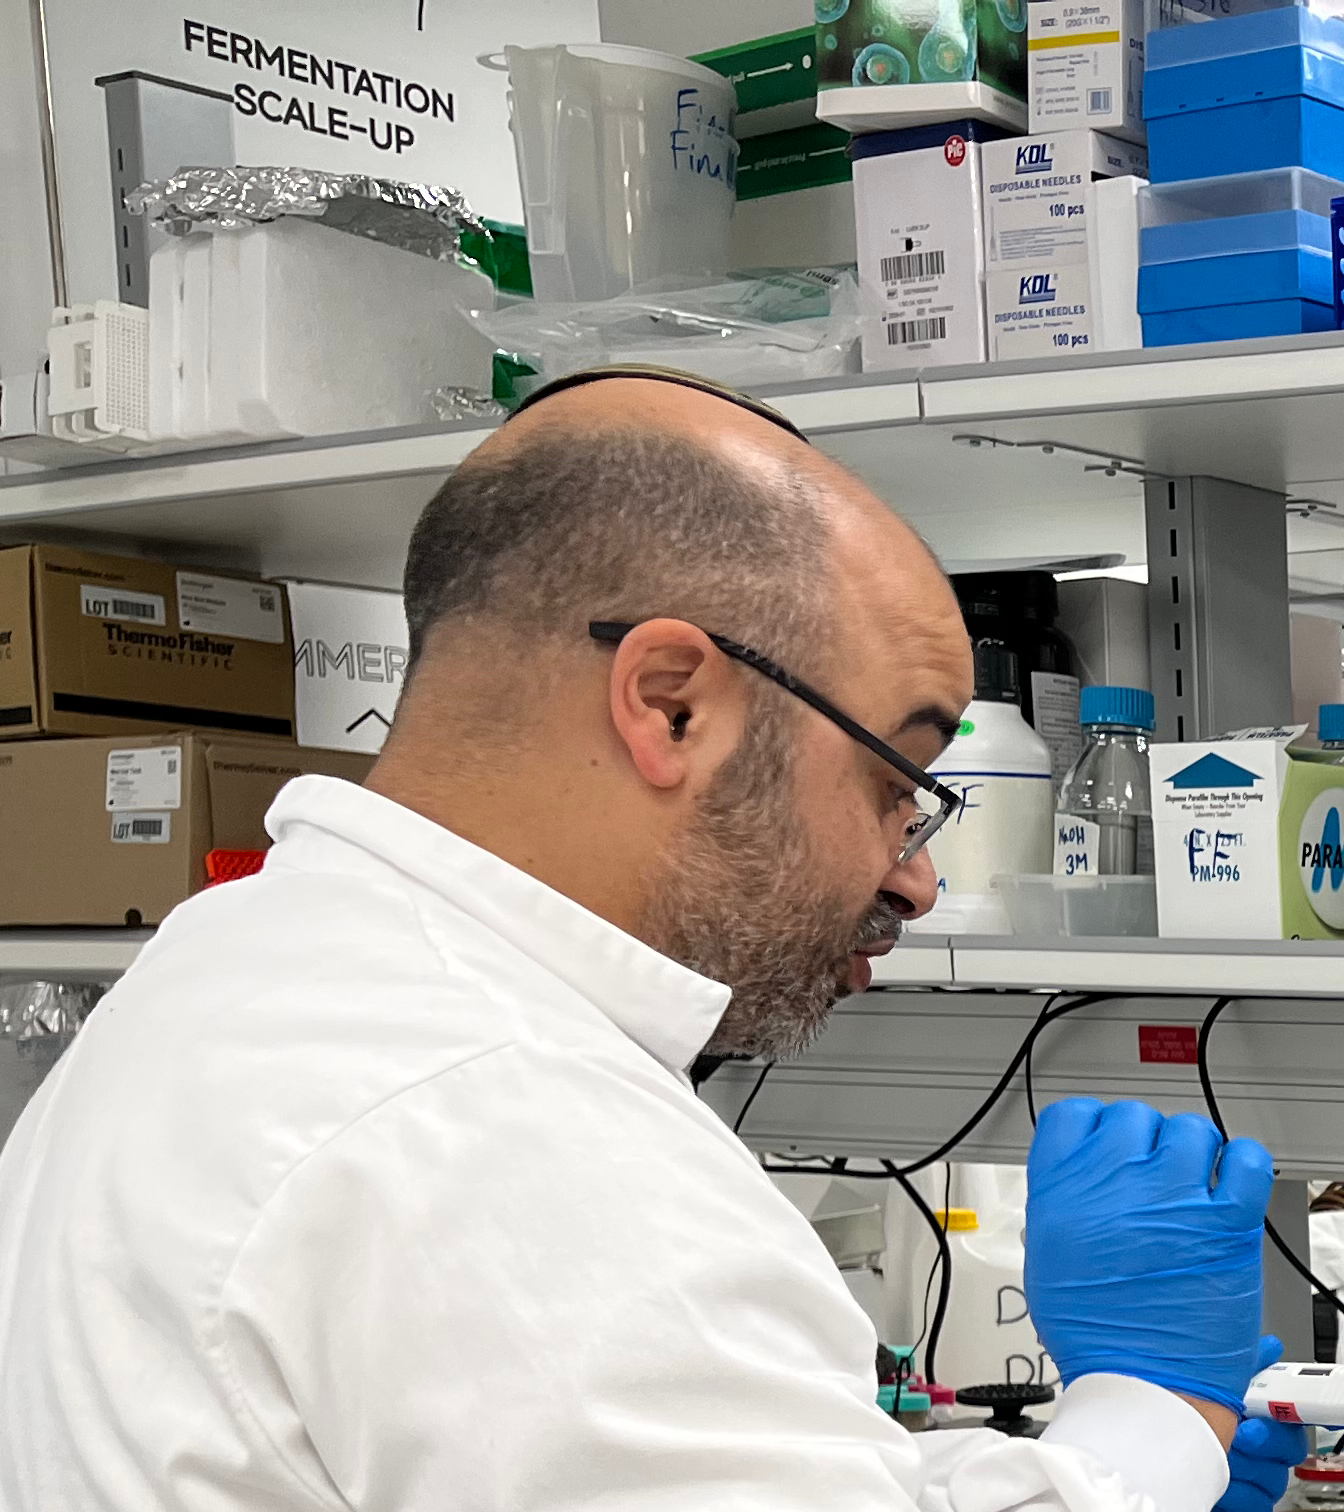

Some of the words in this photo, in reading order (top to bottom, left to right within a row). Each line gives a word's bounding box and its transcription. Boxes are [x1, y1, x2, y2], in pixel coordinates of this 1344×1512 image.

[182, 19, 456, 123] FERMENTATION
[232, 83, 416, 155] SCALE-UP
[989, 178, 1041, 194] DISPOSABLE
[1042, 174, 1082, 188] NEEDLES
[1049, 204, 1066, 217] 100
[1067, 204, 1084, 218] pcs
[995, 307, 1044, 324] DISPOSABLE
[1045, 304, 1086, 318] NEEDLES
[1052, 334, 1069, 347] 100
[1071, 334, 1089, 349] pcs
[86, 599, 110, 618] LOT
[107, 643, 234, 672] SCIENTIFIC
[1188, 793, 1209, 802] Parafilm
[1210, 793, 1230, 803] Through
[1231, 792, 1241, 801] This
[1242, 792, 1264, 803] Opening
[1065, 852, 1088, 876] 3M
[1193, 864, 1240, 882] PM-996
